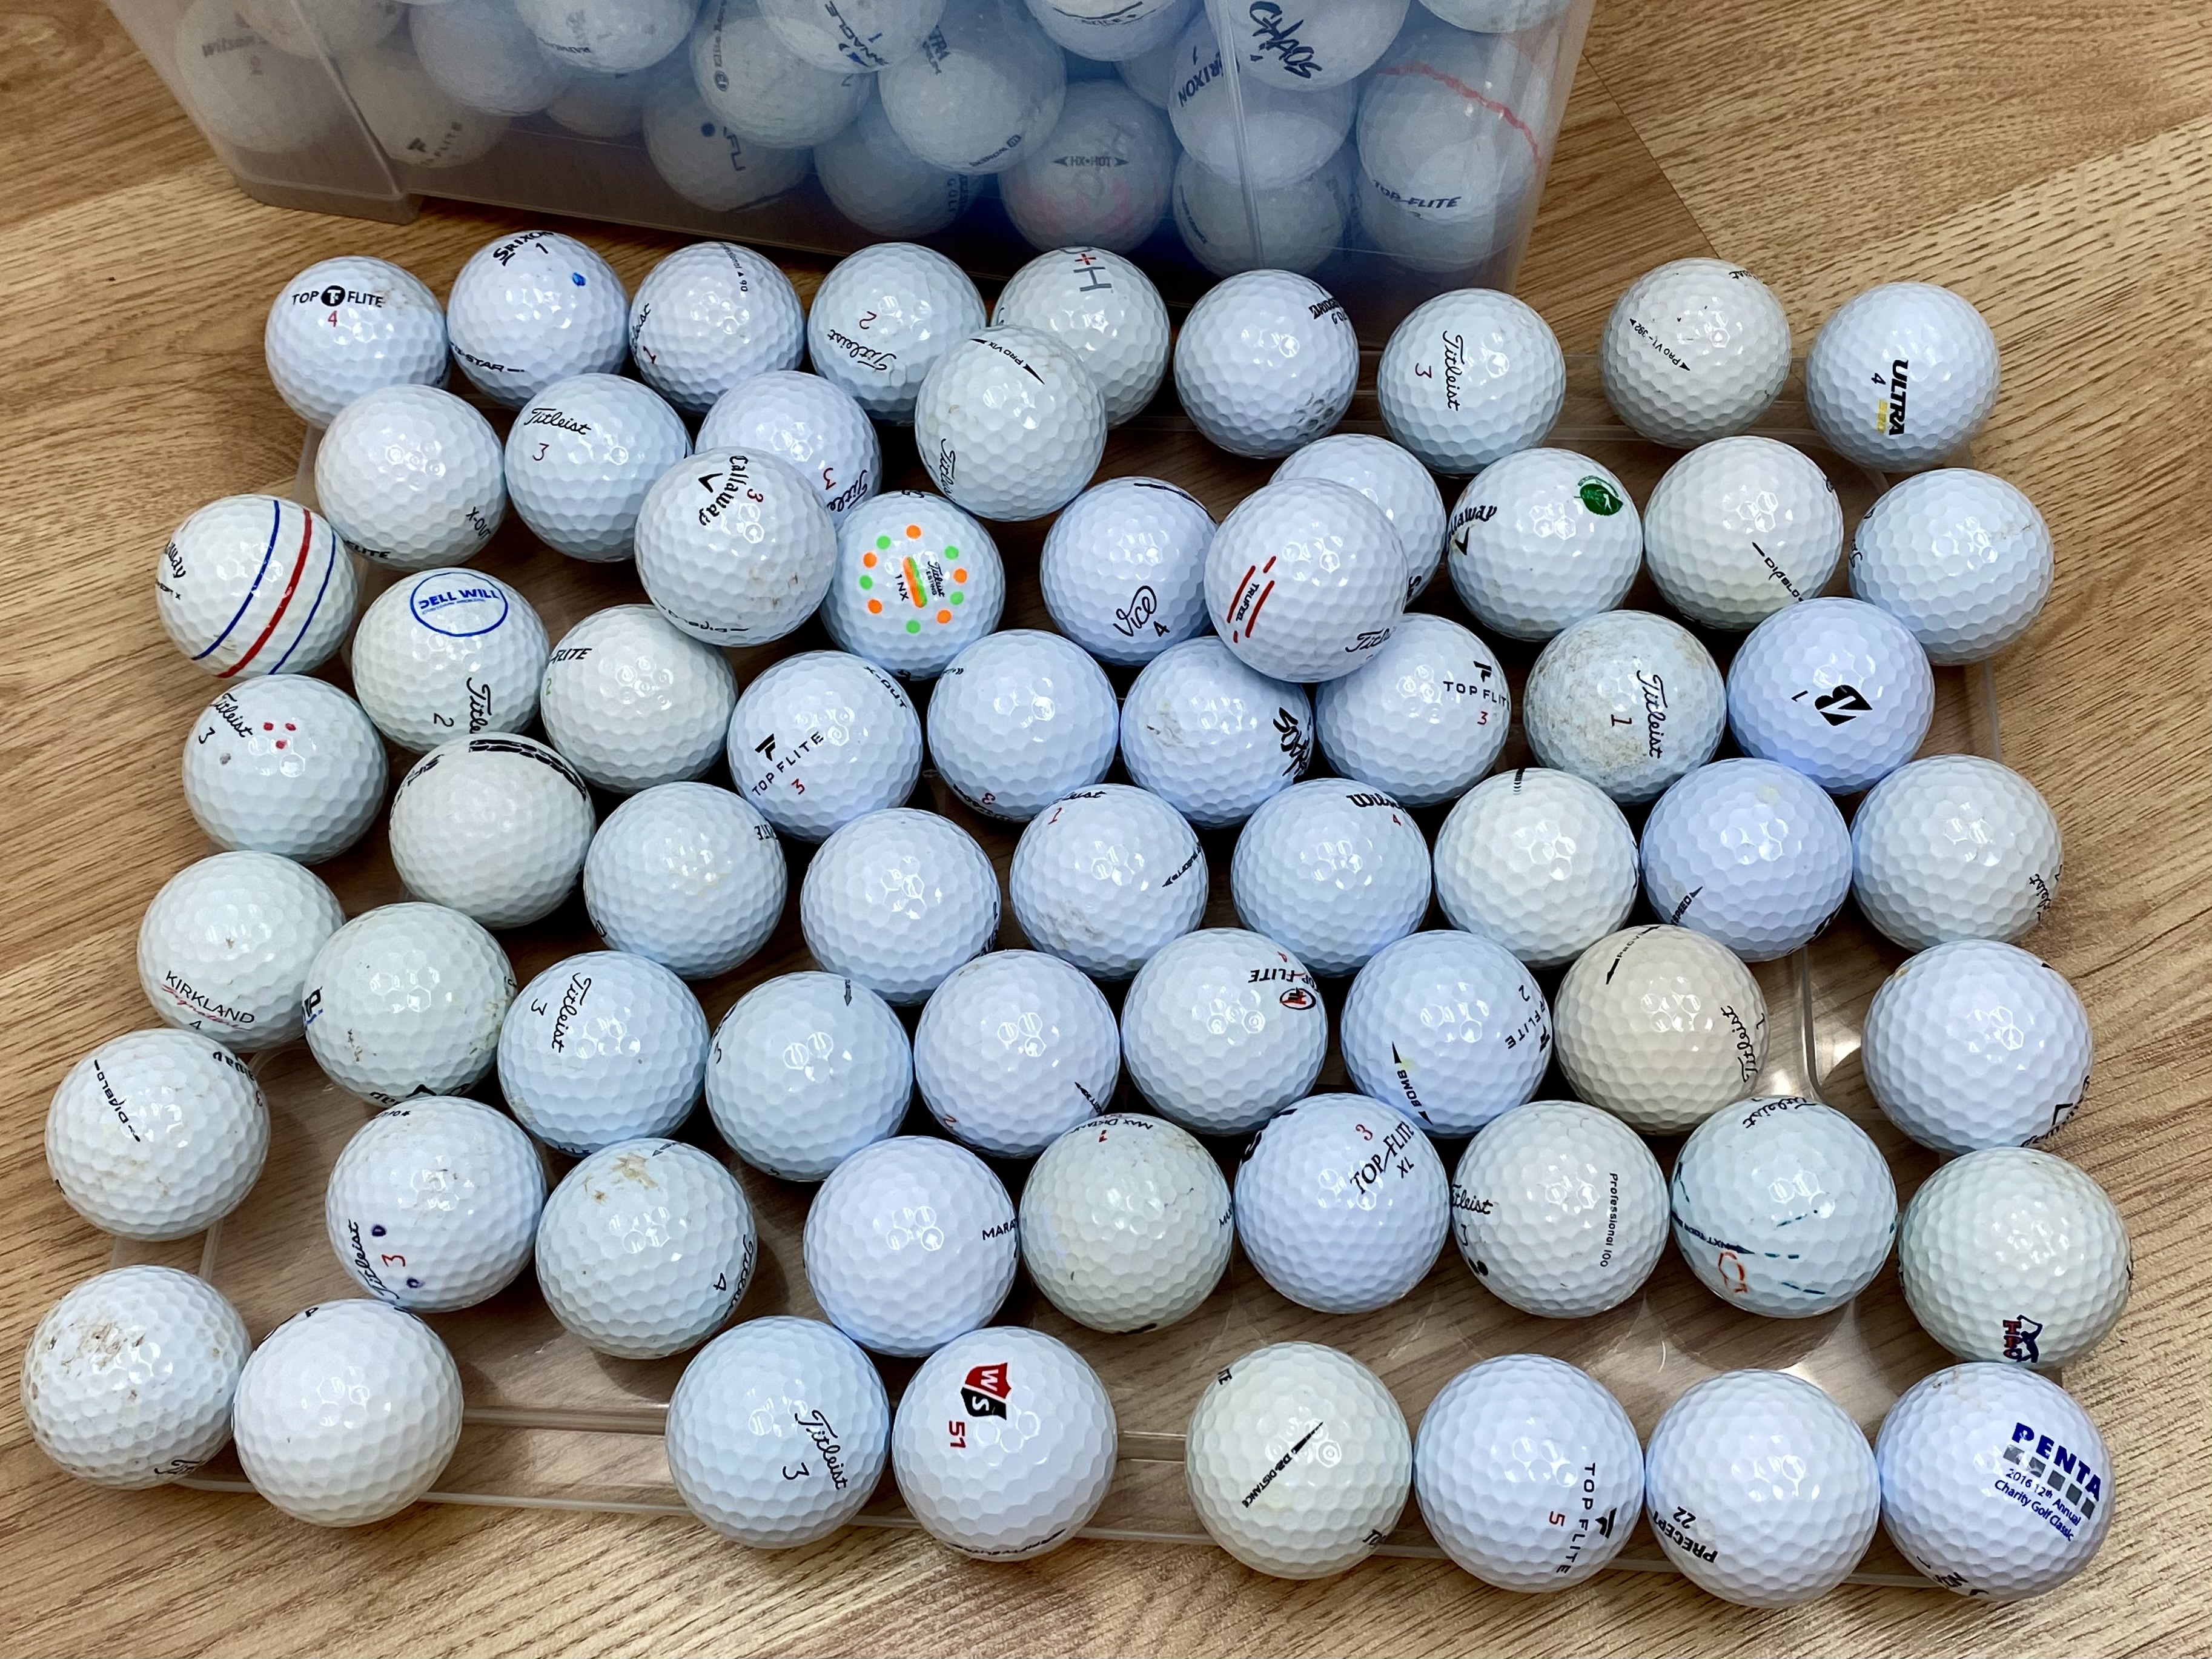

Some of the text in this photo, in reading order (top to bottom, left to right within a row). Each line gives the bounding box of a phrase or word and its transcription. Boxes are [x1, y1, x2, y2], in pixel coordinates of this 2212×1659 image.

[536, 242, 549, 254] 1
[739, 279, 749, 293] 90
[292, 291, 319, 305] TOP
[348, 291, 383, 308] FLITE
[328, 310, 338, 328] 4
[859, 311, 877, 329] 2
[827, 328, 897, 371] Titleist
[1003, 349, 1024, 366] PRO
[1663, 348, 1681, 366] PRO
[1415, 363, 1432, 379] 3
[1442, 330, 1465, 412] Titleist
[1871, 371, 1886, 386] 4
[1889, 359, 1909, 436] ULTRA
[524, 408, 591, 435] Titleist
[532, 443, 549, 462] 3
[699, 454, 749, 526] Callaway
[823, 468, 836, 490] 3
[746, 488, 764, 503] 3
[466, 507, 491, 540] X-OUT
[928, 560, 945, 598] Titleist
[1763, 557, 1800, 599] DIABLO
[1113, 585, 1157, 637] Vice
[1152, 620, 1170, 637] 4
[864, 666, 907, 709] X-OUT
[1443, 680, 1478, 697] TOP
[211, 692, 253, 739] Titleist
[432, 712, 454, 728] 2
[1477, 710, 1488, 726] 3
[1611, 714, 1632, 727] 1
[1637, 669, 1668, 759] Titleist
[198, 727, 215, 744] 3
[751, 731, 824, 796] TOP FLITE
[791, 778, 805, 795] 3
[981, 792, 996, 806] 3
[1047, 807, 1063, 825] 1
[165, 970, 256, 1025] KIRKLAND
[1518, 984, 1531, 1002] 2
[531, 998, 549, 1015] 3
[551, 972, 592, 1053] Titleist
[189, 1019, 202, 1030] 4
[1720, 1005, 1758, 1083] Titleist
[96, 1071, 129, 1125] DIABLO
[1396, 1068, 1422, 1107] BOMB
[1354, 1123, 1373, 1142] 3
[1396, 1156, 1415, 1179] XL
[1603, 1172, 1619, 1246] Professional
[347, 1219, 401, 1300] Titleist
[380, 1254, 406, 1268] 3
[714, 1273, 727, 1291] 4
[948, 1419, 967, 1449] 51
[794, 1409, 848, 1490] Titleist
[782, 1462, 810, 1481] 3
[2012, 1422, 2101, 1502] PENTA
[2005, 1468, 2033, 1488] 2016
[2052, 1498, 2082, 1526] Annual
[1548, 1511, 1565, 1526] 5
[1554, 1462, 1596, 1575] TOP FLITE
[1675, 1506, 1698, 1530] 22
[1995, 1480, 2075, 1541] Charity Golf Classic
[1651, 1509, 1719, 1564] PRECEPT
